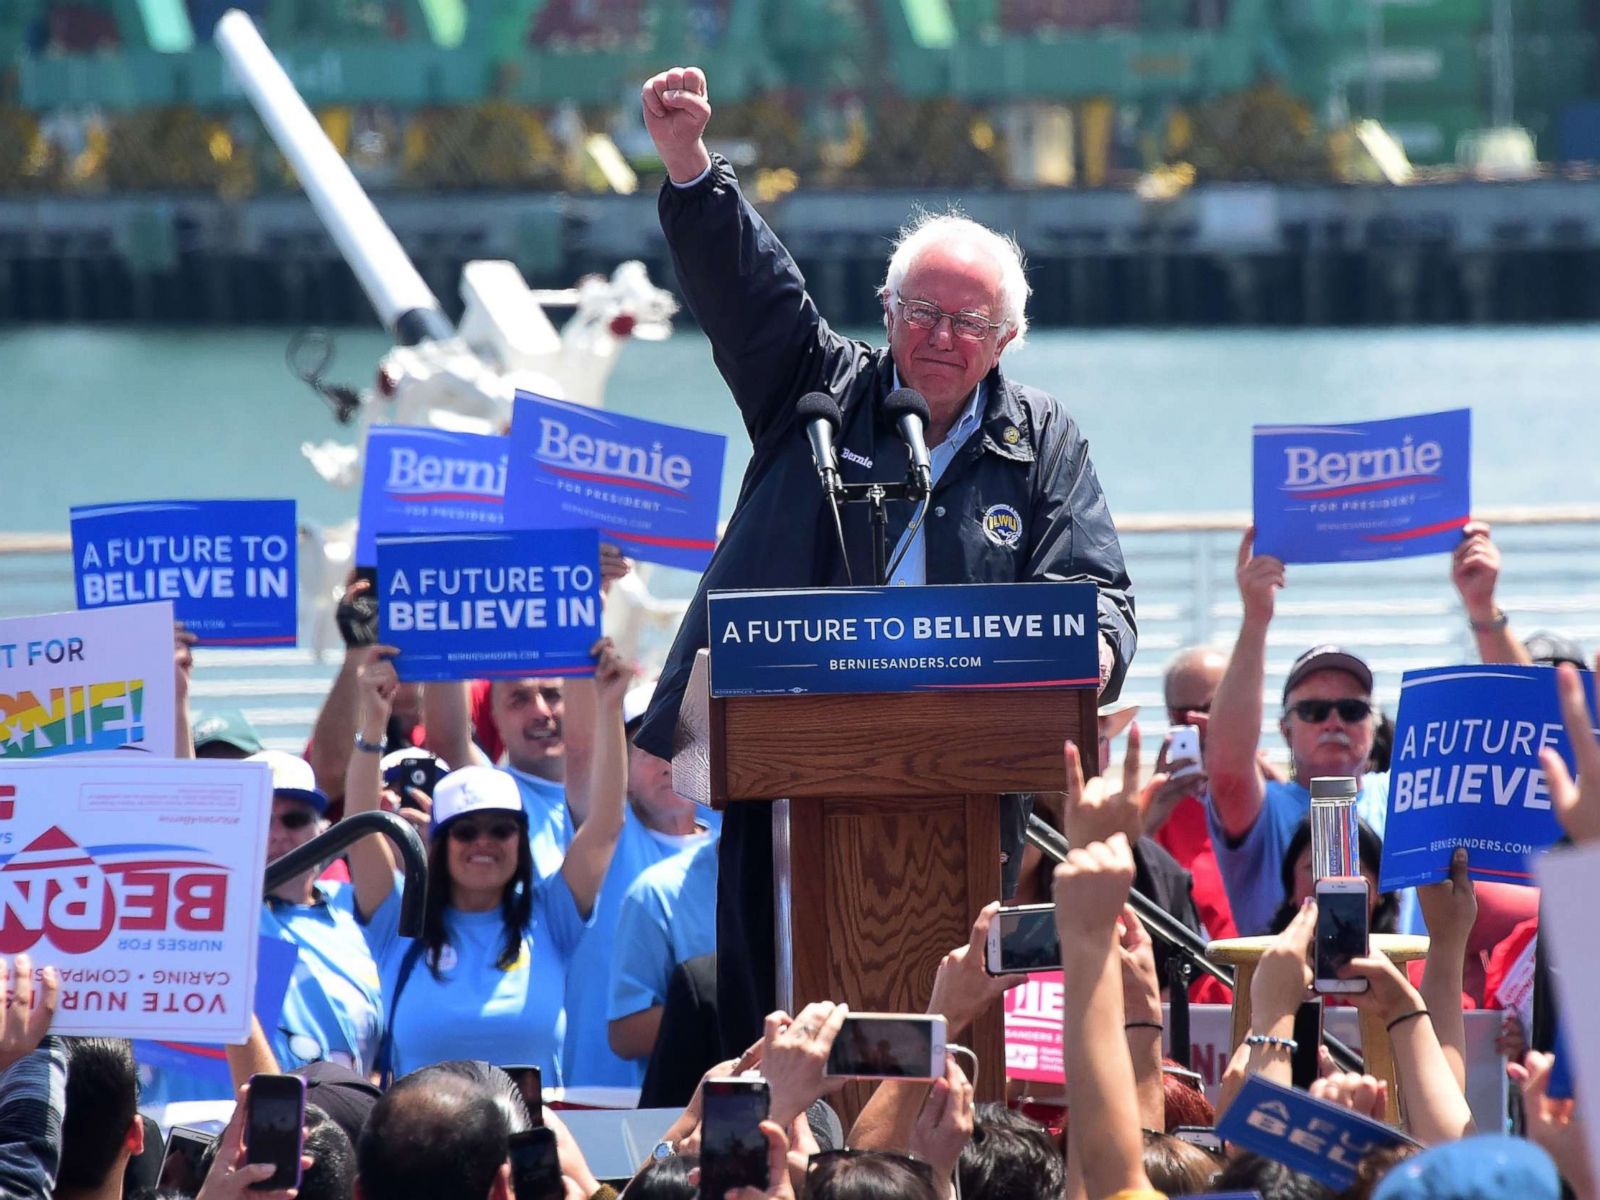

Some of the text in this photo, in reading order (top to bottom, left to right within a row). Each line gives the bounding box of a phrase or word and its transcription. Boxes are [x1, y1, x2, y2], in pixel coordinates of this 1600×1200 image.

[537, 417, 692, 489] Bernie
[840, 447, 873, 468] Bernie
[1283, 433, 1443, 487] Bernie
[389, 447, 508, 498] Berni
[556, 480, 661, 513] FOR PRESIDENT
[1310, 494, 1416, 513] FOR PRESIDENT
[989, 514, 1017, 530] ILWU
[82, 534, 288, 570] A FUTURE TO
[83, 567, 288, 604] BELIEVE IN
[390, 565, 593, 595] A FUTURE TO
[388, 597, 595, 631] BELIEVE IN
[722, 613, 1085, 643] A FUTURE TO BELIEVE IN
[27, 637, 84, 666] FOR
[829, 656, 982, 670] BERNIESANDERS.COM
[1400, 719, 1564, 760] A FUTURE
[1394, 764, 1552, 813] BELIEVE
[1430, 838, 1532, 855] BERNIESANDERS.COM
[117, 937, 222, 951] NURSES FOR
[152, 969, 230, 985] CARING
[142, 991, 226, 1013] VOTE
[1257, 1100, 1291, 1121] A
